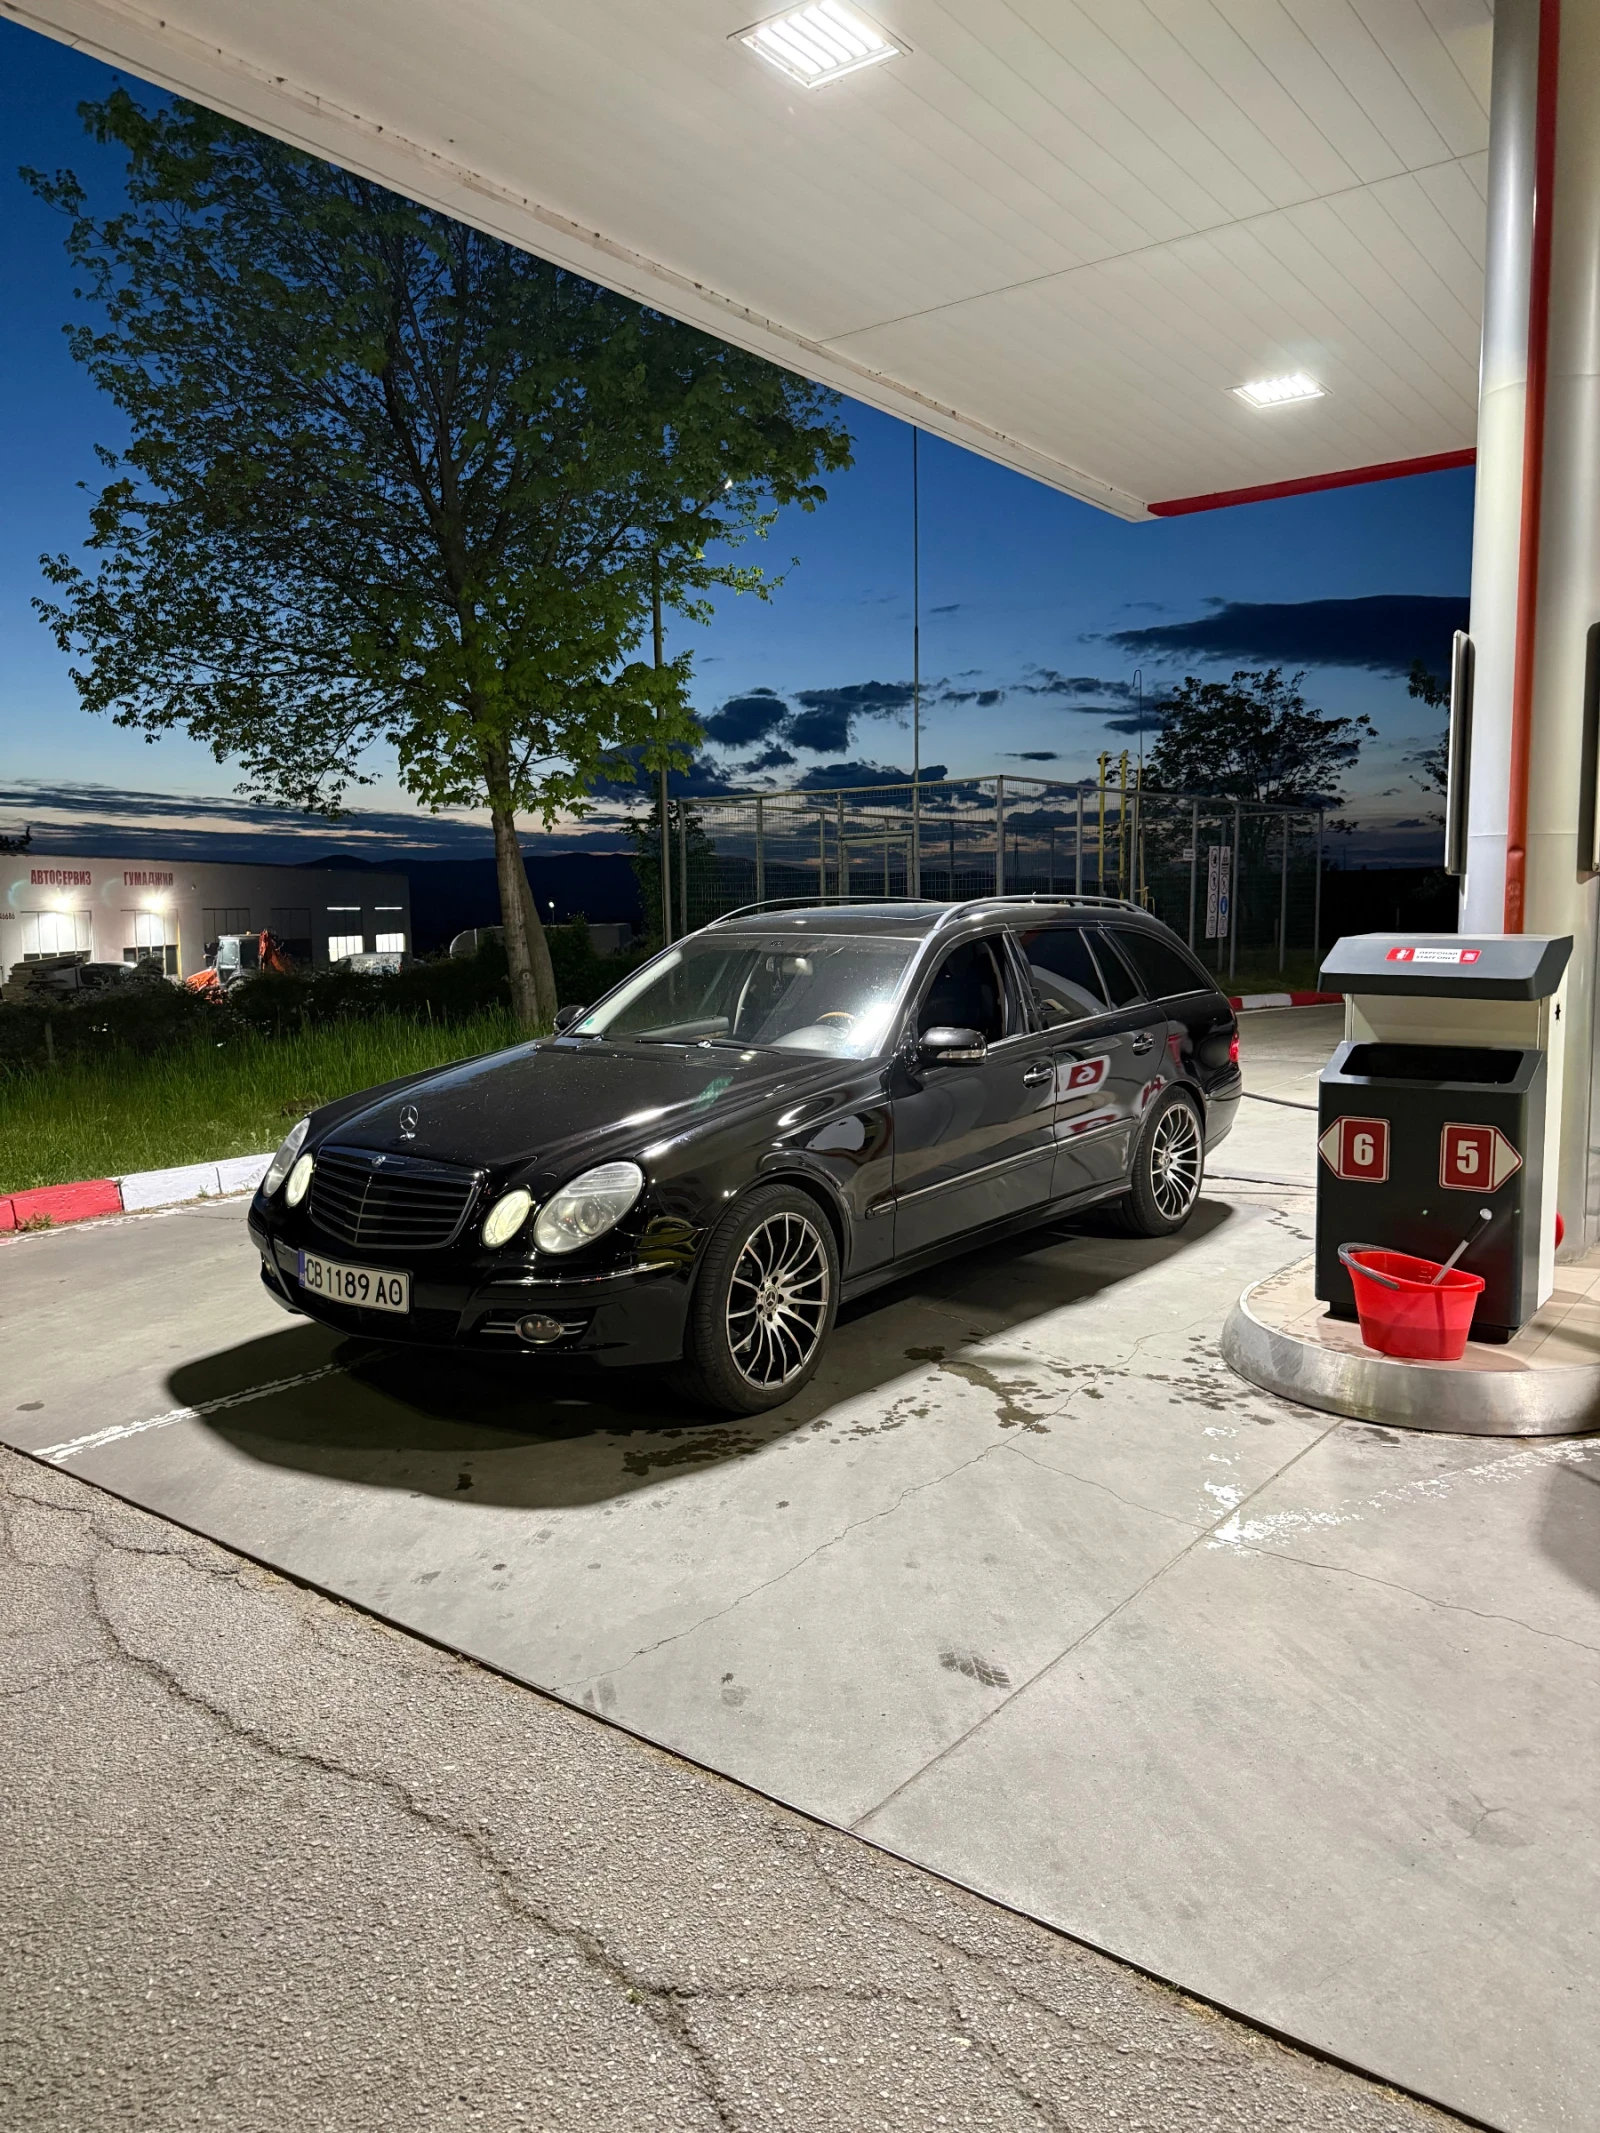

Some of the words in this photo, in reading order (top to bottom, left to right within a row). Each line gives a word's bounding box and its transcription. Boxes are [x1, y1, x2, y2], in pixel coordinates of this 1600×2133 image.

[31, 869, 92, 885] АВТОСЕРВИЗ
[123, 871, 174, 886] ГУМАДЖИЯ
[1353, 1133, 1374, 1165] 6
[1456, 1140, 1479, 1174] 5
